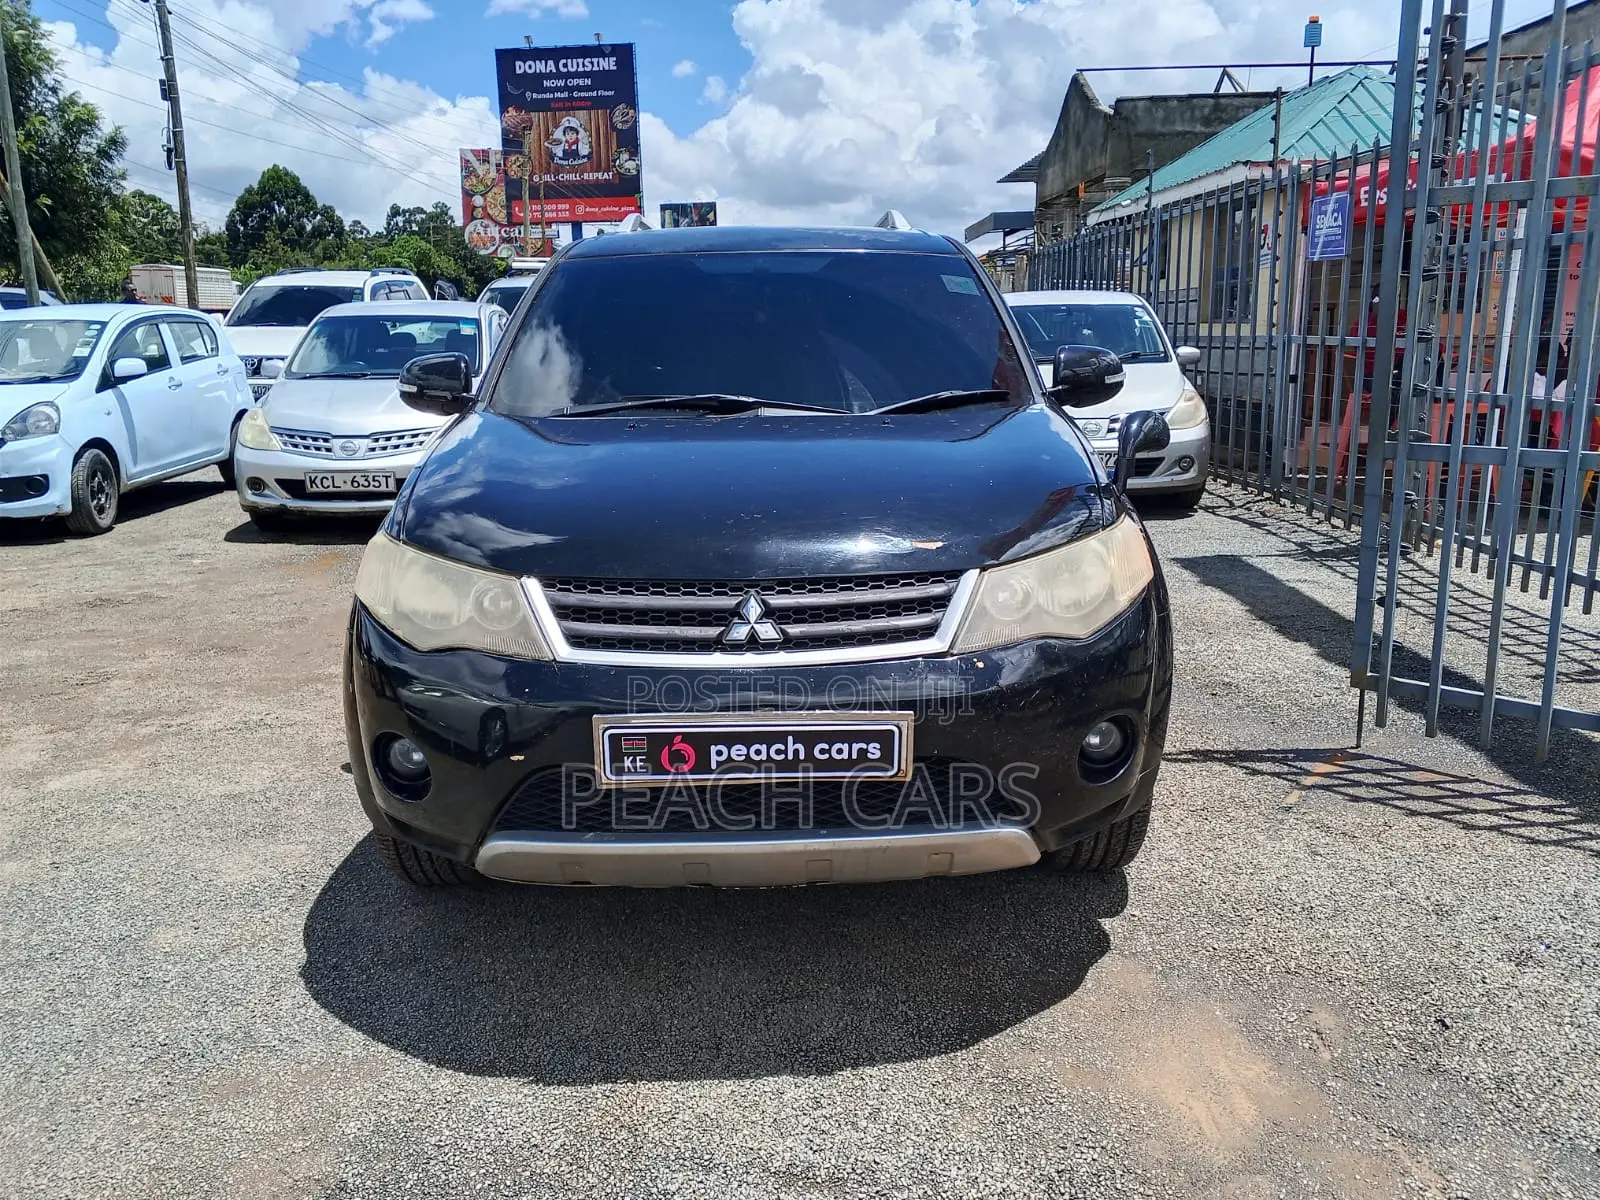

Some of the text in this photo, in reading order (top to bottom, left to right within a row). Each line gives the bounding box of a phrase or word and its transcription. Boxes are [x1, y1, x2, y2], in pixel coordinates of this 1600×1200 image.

[515, 57, 617, 74] DONA CUISINE
[543, 78, 591, 87] NOW OPEN
[309, 474, 392, 489] KCL 635T
[710, 735, 882, 770] peach cars
[624, 755, 647, 772] KE
